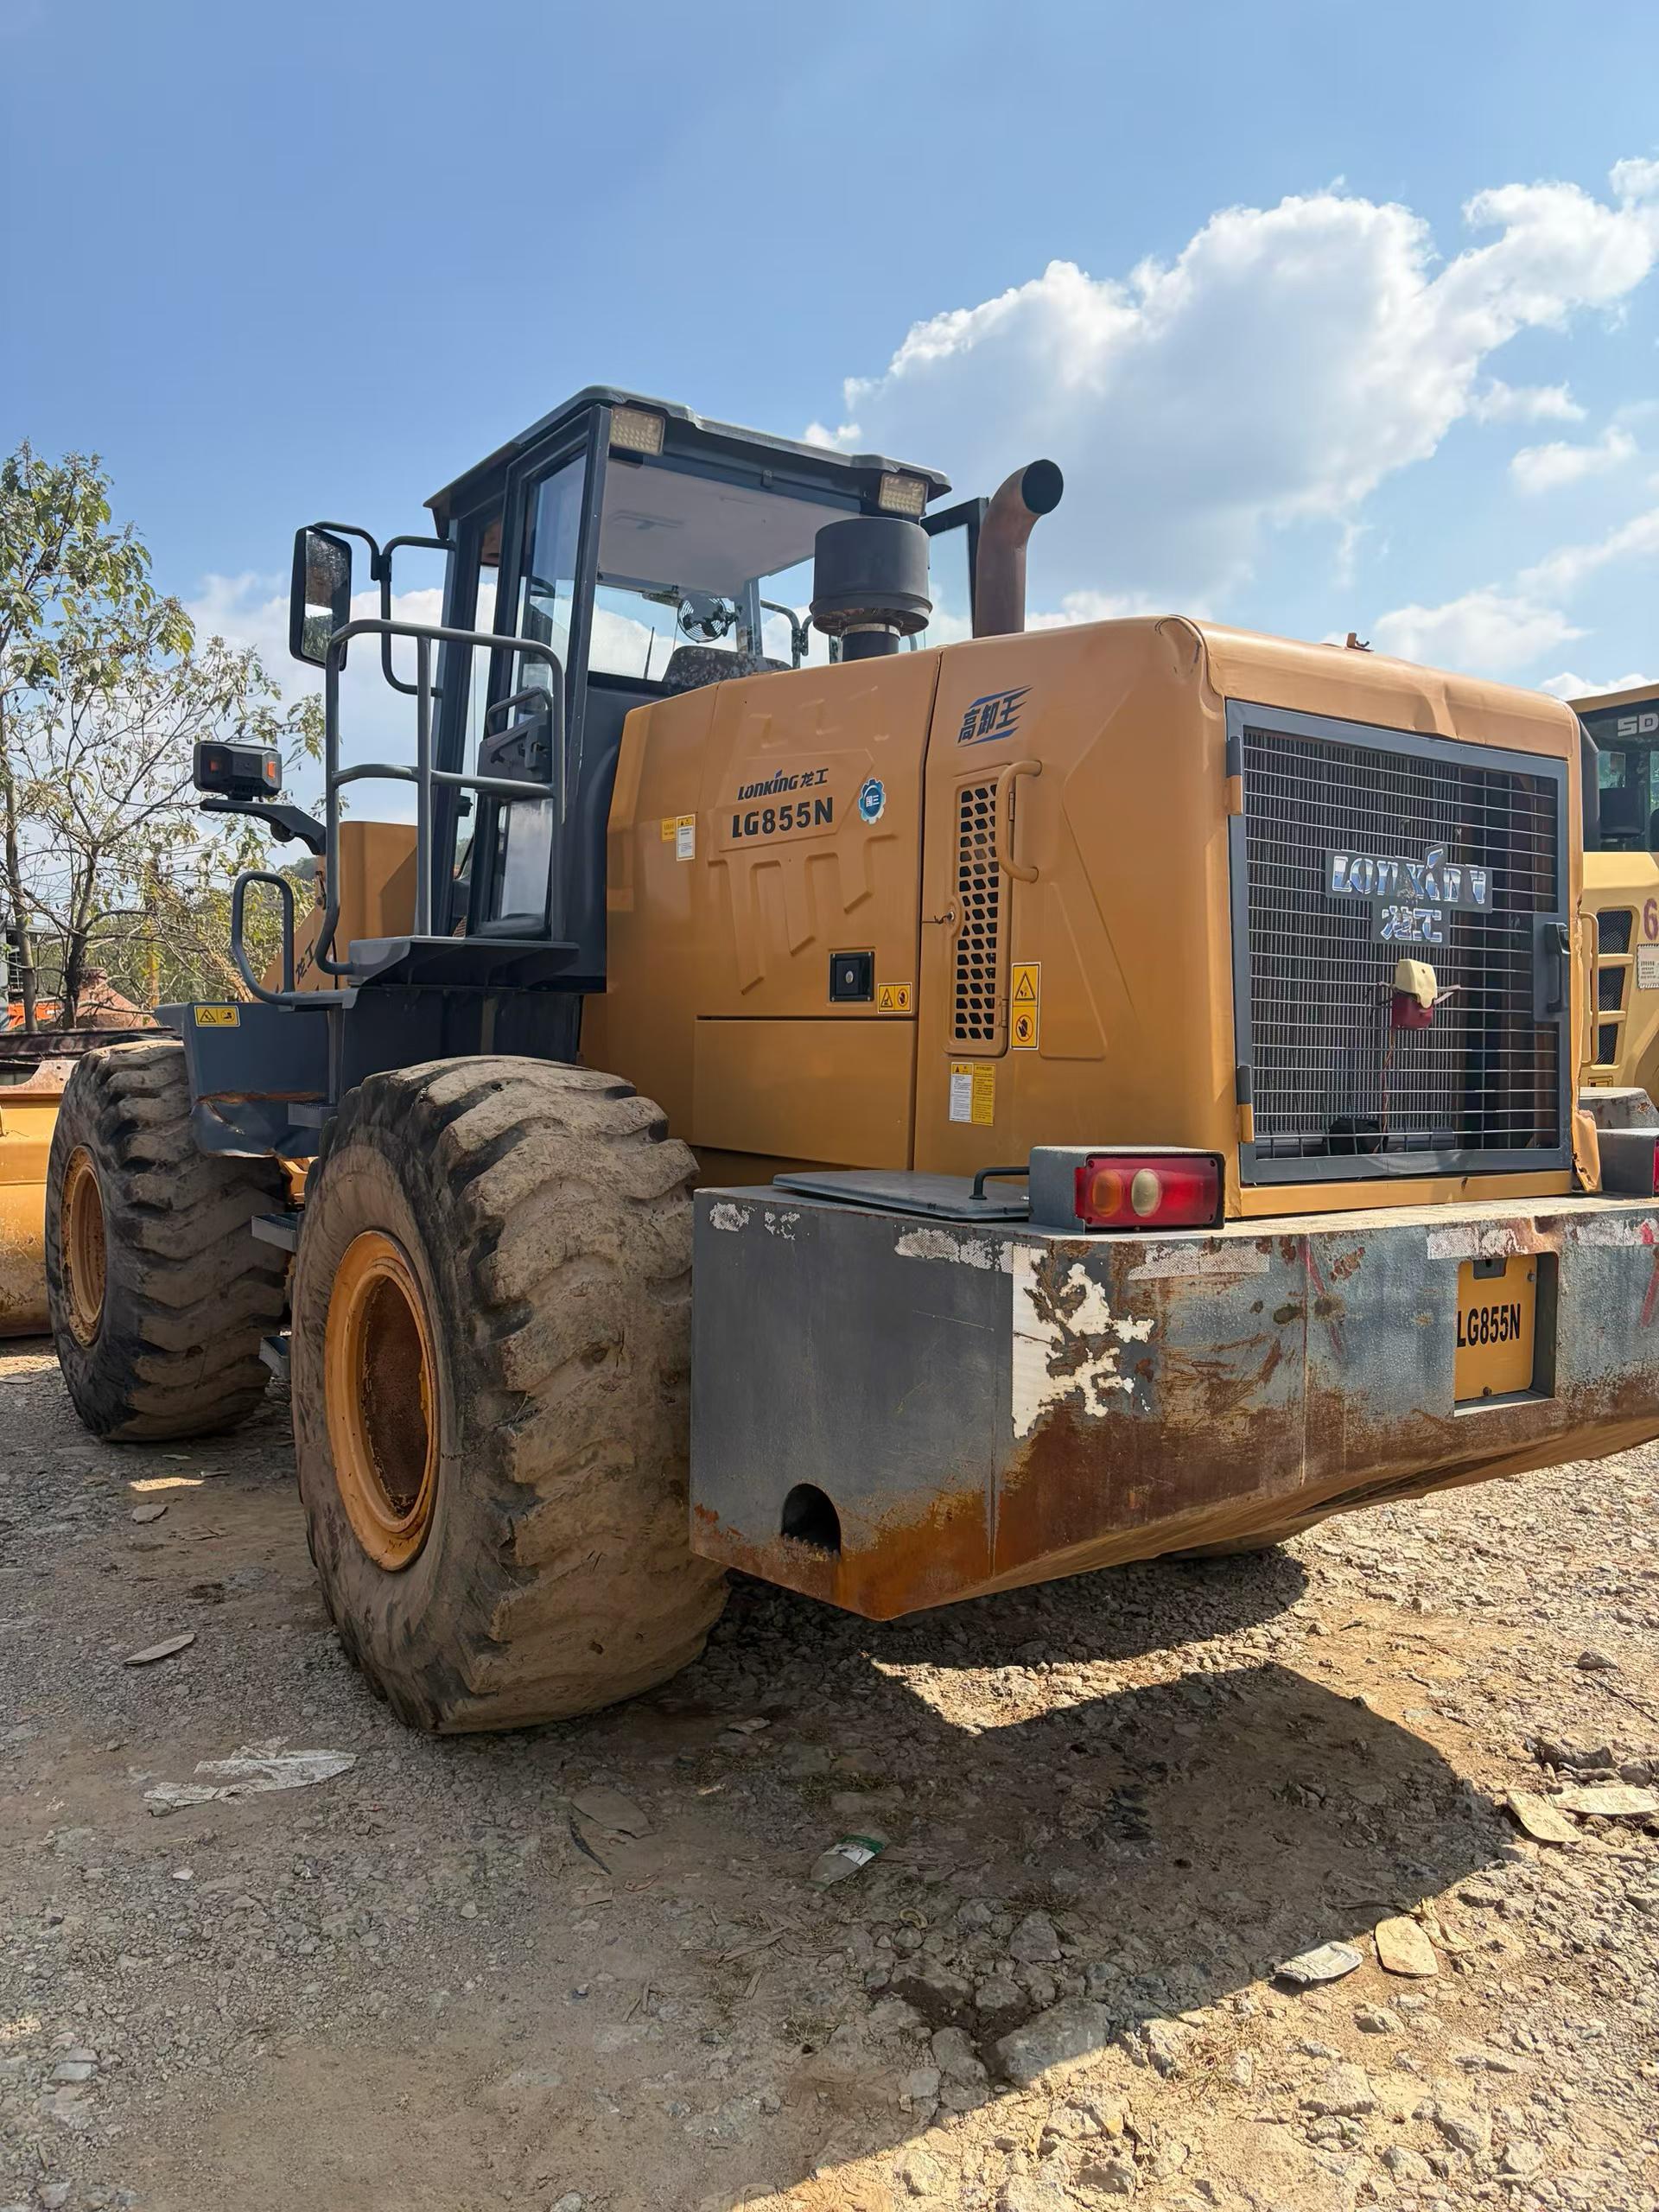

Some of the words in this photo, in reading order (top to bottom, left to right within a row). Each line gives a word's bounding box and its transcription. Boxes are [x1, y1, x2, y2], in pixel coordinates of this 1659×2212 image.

[957, 687, 1033, 744] 高卸王
[800, 768, 830, 788] 龙工
[732, 797, 833, 838] LG855N
[1457, 1303, 1521, 1348] LG855N
